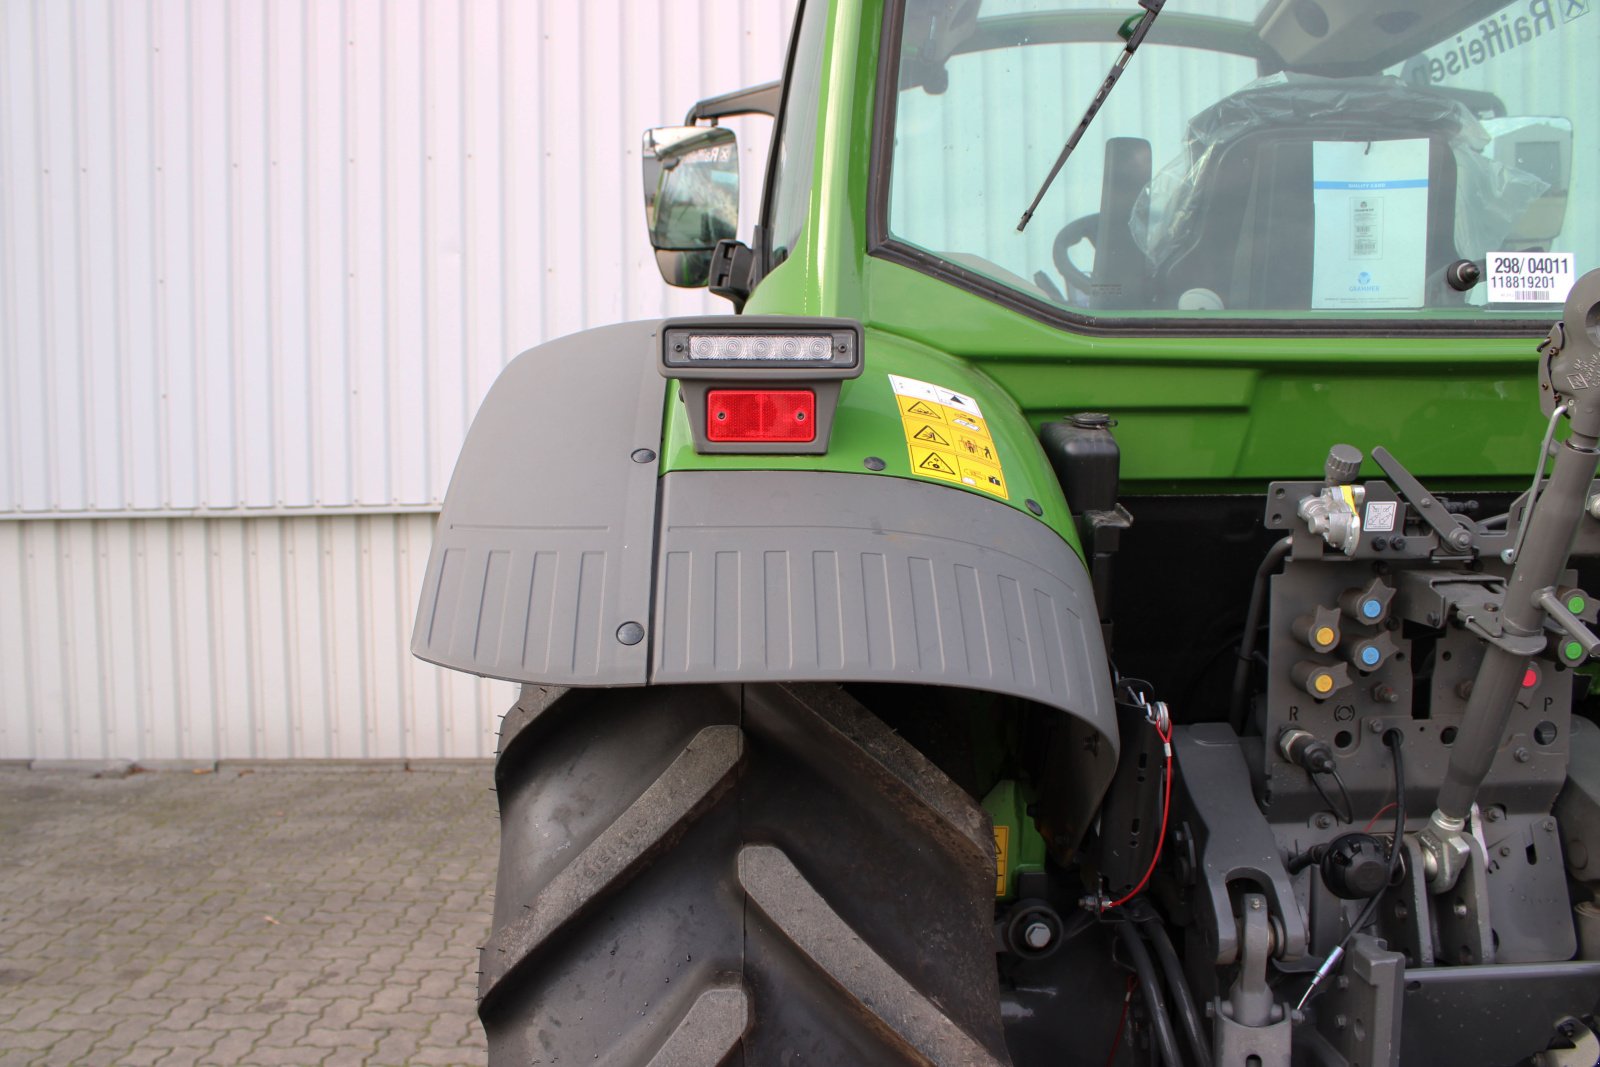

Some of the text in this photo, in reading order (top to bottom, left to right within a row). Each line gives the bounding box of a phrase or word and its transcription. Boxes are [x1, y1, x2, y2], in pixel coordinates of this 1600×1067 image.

[1491, 276, 1555, 289] 118819201
[1544, 696, 1553, 712] P
[1289, 705, 1298, 721] R
